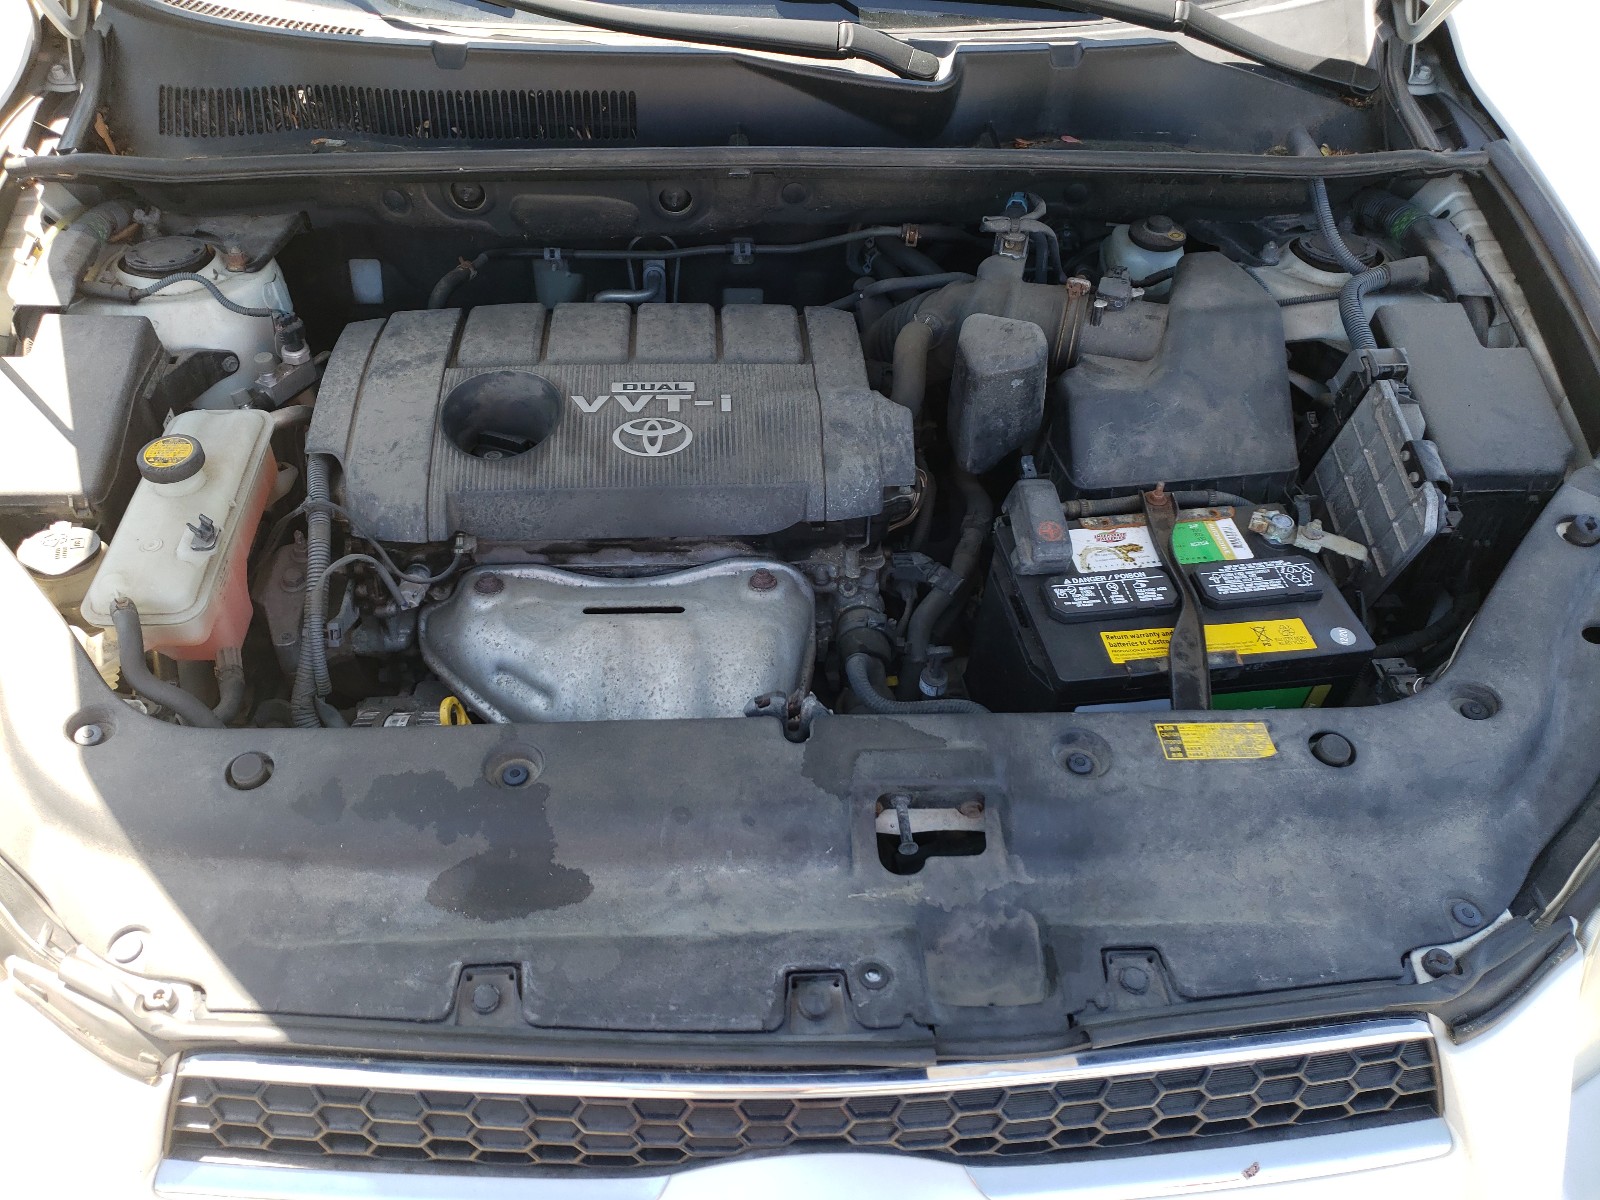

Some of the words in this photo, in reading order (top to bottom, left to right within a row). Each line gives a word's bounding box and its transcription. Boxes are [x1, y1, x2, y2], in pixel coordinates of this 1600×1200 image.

[622, 383, 688, 391] DUAL
[571, 394, 732, 413] VVT-i
[1071, 575, 1107, 584] DANGER
[1113, 571, 1147, 580] POISON
[1105, 633, 1129, 641] Return
[1129, 631, 1160, 640] warranty
[1108, 640, 1139, 648] batteries
